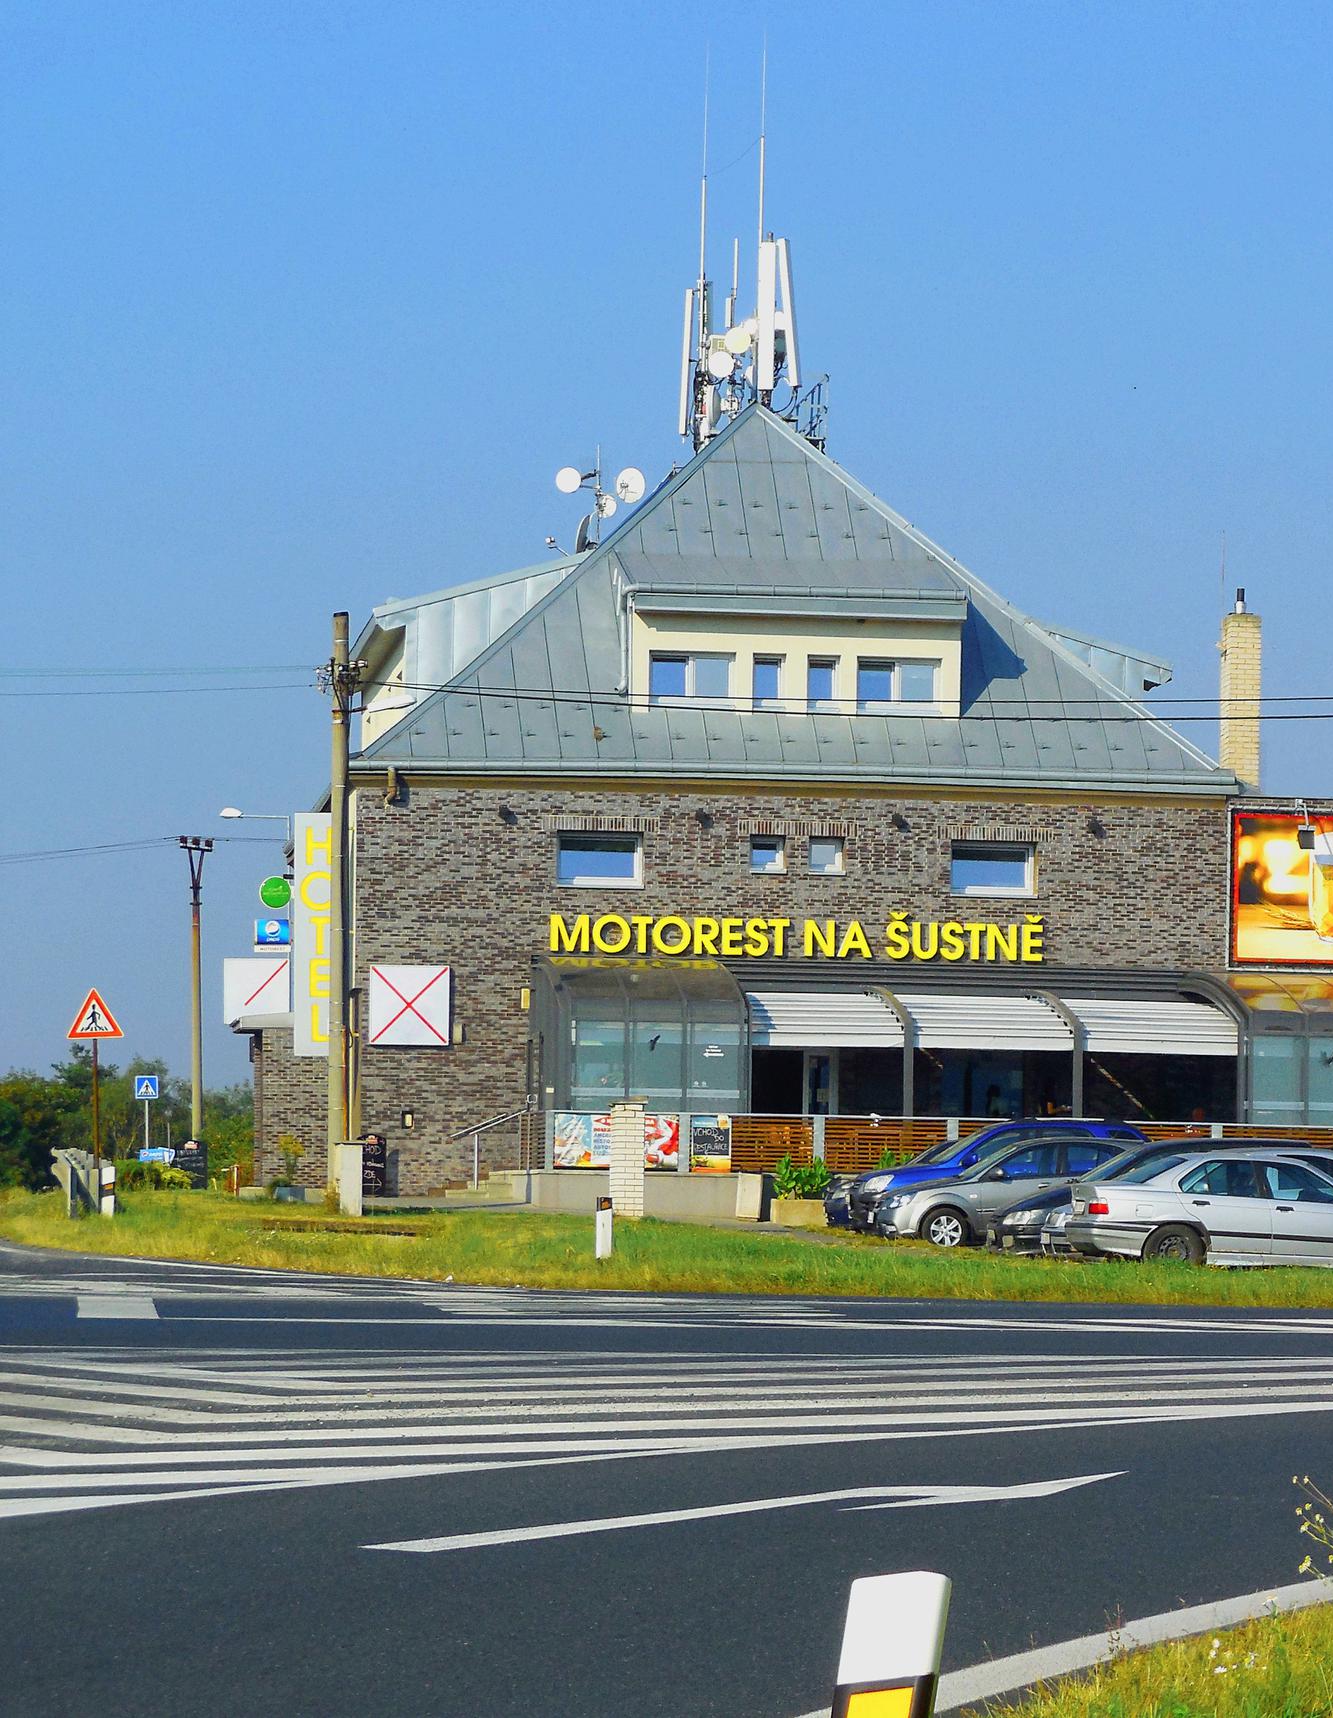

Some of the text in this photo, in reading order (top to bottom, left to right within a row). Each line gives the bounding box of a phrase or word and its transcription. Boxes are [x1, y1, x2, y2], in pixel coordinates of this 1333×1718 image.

[300, 826, 332, 1043] HOTEL
[549, 912, 1044, 962] MOTOREST NA ŠUSTNĚ
